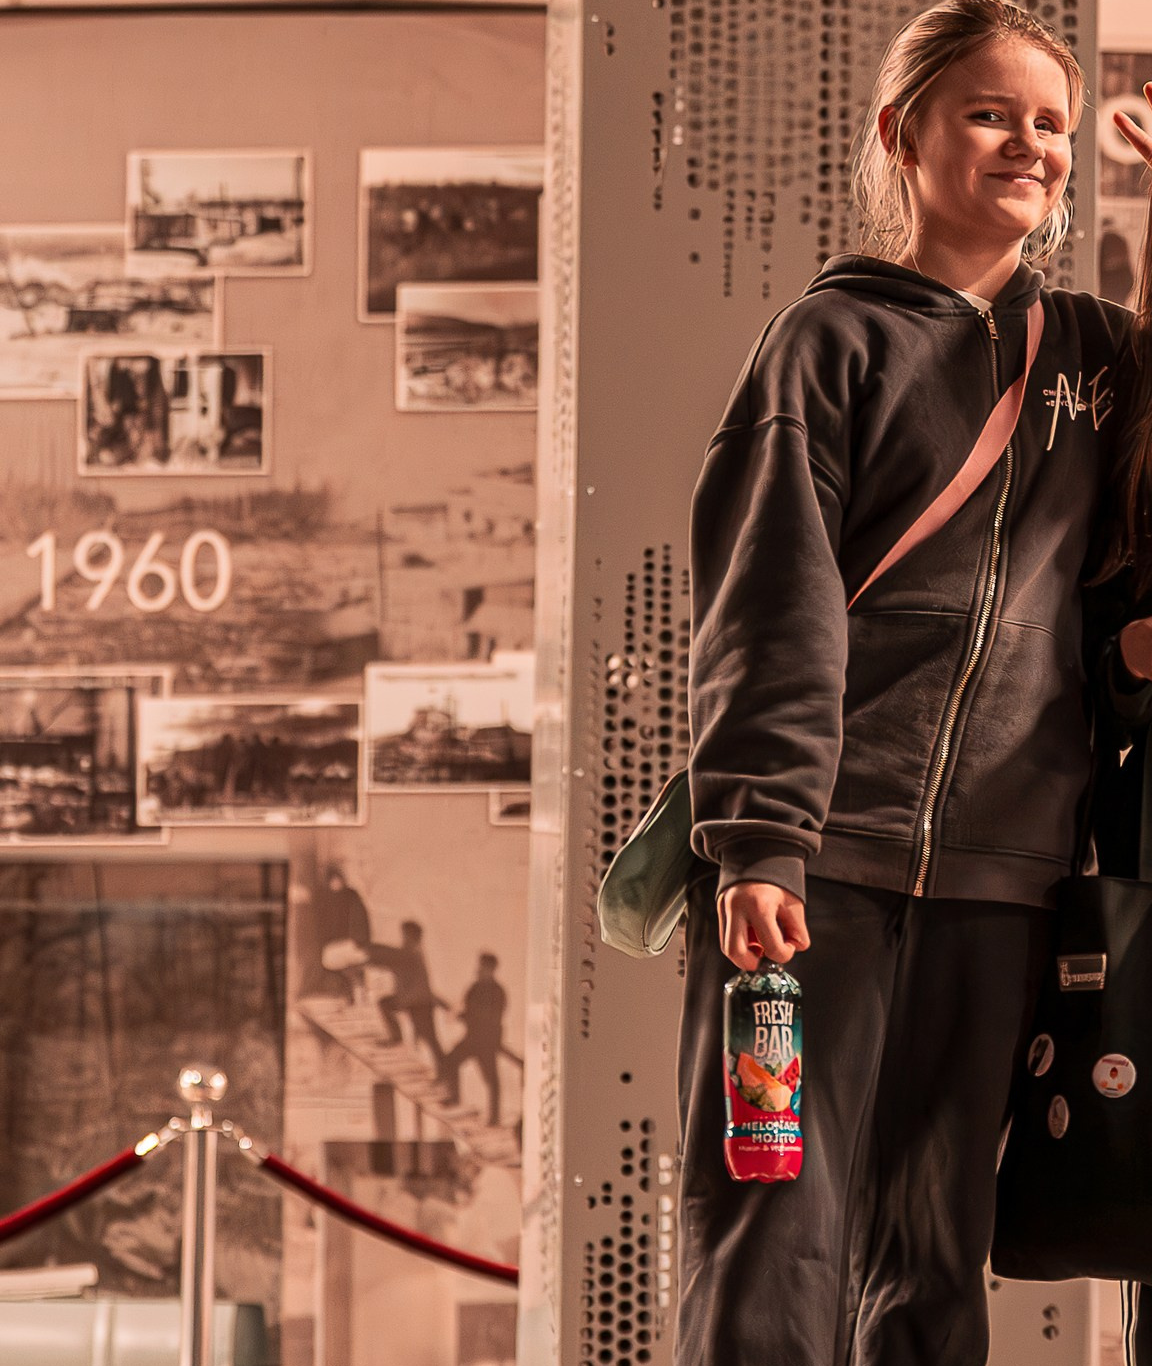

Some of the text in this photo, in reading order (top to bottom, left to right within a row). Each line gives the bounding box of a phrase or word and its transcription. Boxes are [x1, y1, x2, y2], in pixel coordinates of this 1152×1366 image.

[26, 528, 232, 612] 1960
[753, 1000, 794, 1025] FRESH
[754, 1025, 794, 1061] BAR
